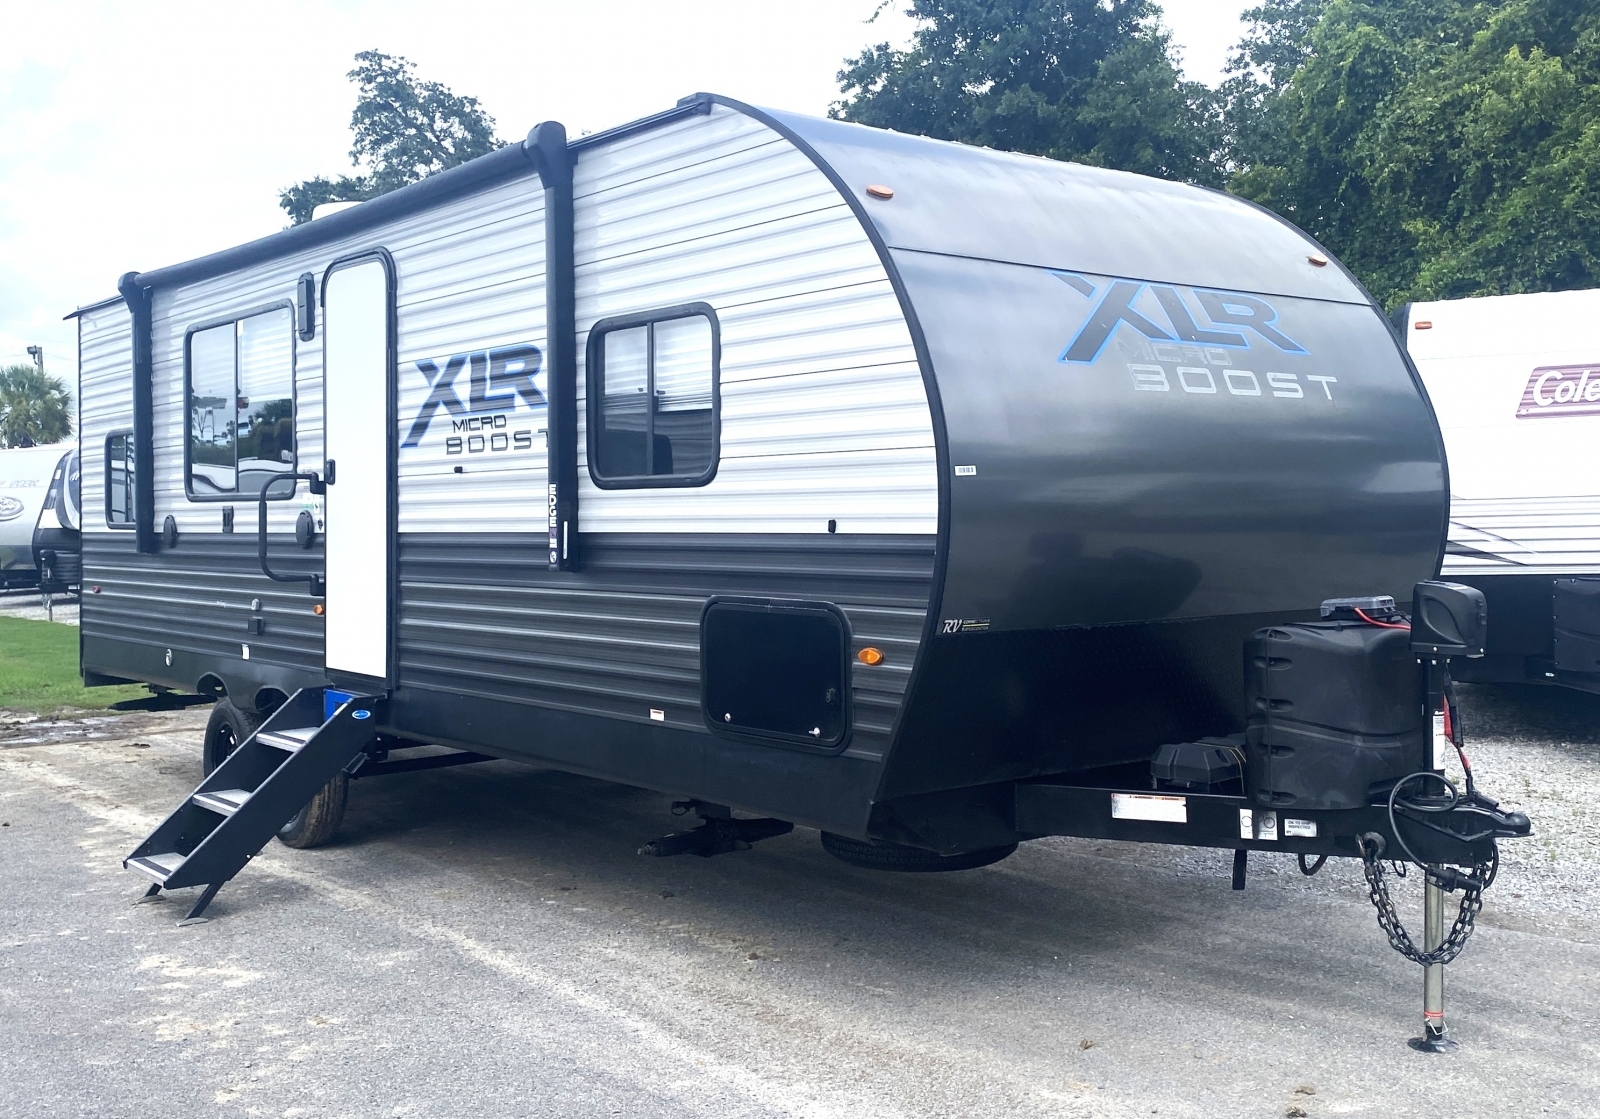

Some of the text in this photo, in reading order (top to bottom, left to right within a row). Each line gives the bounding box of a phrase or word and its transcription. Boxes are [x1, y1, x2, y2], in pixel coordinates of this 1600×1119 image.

[1045, 269, 1312, 366] XLR
[1117, 341, 1233, 366] MICRO
[401, 344, 548, 449] XLR
[1127, 363, 1338, 401] BOOST
[1533, 369, 1600, 407] Cole
[452, 414, 507, 433] MICRO
[548, 483, 557, 528] EDGE
[943, 619, 963, 634] RV
